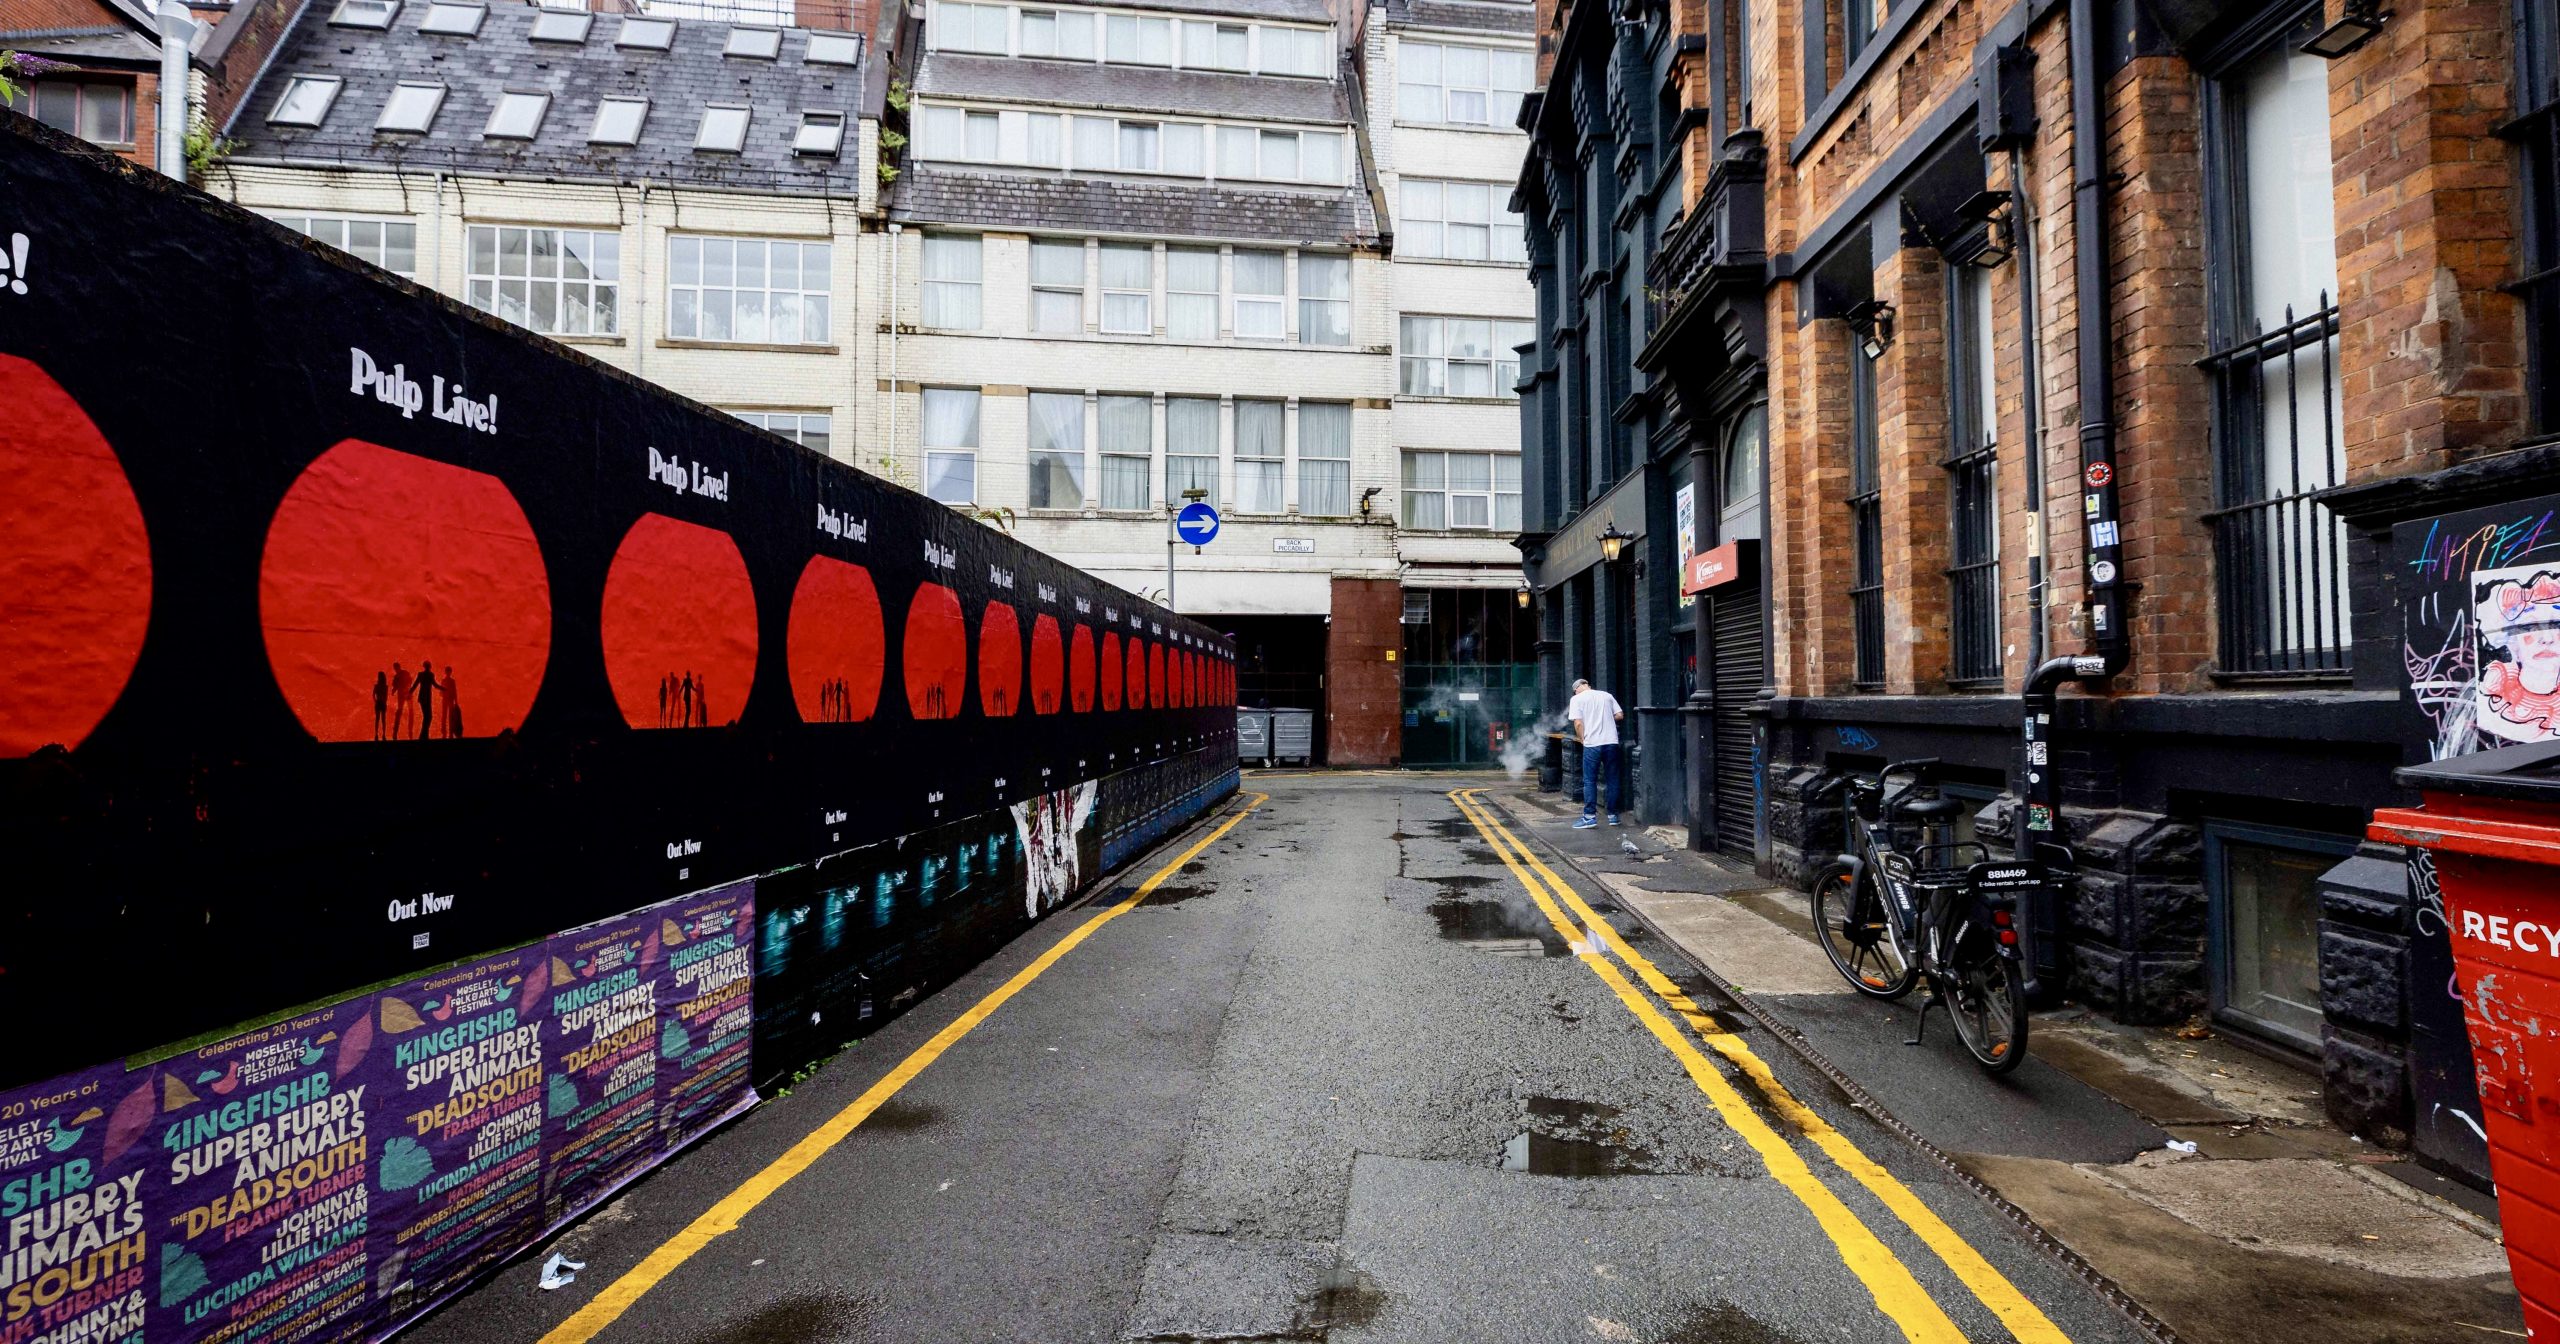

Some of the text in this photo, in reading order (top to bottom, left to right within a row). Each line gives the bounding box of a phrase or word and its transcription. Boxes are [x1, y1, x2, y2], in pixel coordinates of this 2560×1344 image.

[350, 347, 498, 435] Pulp Live!
[648, 447, 729, 502] Pulp Live!
[817, 503, 867, 543] Pulp Live!
[924, 539, 940, 569] Pulp
[667, 838, 701, 859] Out Now
[1988, 869, 2027, 878] 88M469
[388, 892, 454, 922] Out Now
[598, 942, 622, 956] MOSELEY
[598, 958, 622, 972] FESTIVAL
[670, 933, 735, 971] KINGFISHR
[676, 944, 750, 988] SUPER FURRY
[424, 958, 520, 991] Celebrating 20 Years of
[456, 979, 493, 996] MOSELEY
[554, 968, 638, 1016] KINGFISHR
[697, 960, 749, 996] ANIMALS
[450, 993, 471, 1008] FOLK
[478, 986, 499, 1000] ARTS
[456, 997, 493, 1016] FESTIVAL
[562, 980, 656, 1035] SUPER FURRY
[695, 1008, 720, 1026] FRANK
[198, 1010, 334, 1059] Celebrating 20 Years of
[396, 1008, 518, 1070] KINGFISHR
[592, 998, 656, 1043] ANIMALS
[237, 1059, 265, 1078] FOLK
[278, 1046, 306, 1065] ARTS
[246, 1038, 298, 1063] MOSELEY
[406, 1020, 542, 1091] SUPER FURRY
[449, 1041, 542, 1098] ANIMALS
[587, 1036, 656, 1079] FRANK TURNER
[245, 1062, 296, 1086] FESTIVAL
[604, 1060, 656, 1098] LILLIE FLYNN
[2, 1080, 100, 1120] 20 Years of
[406, 1114, 418, 1124] THE
[444, 1086, 541, 1141] FRANK TURNER
[566, 1098, 610, 1132] LUCINDA
[610, 1074, 656, 1105] WILLIAMS
[11, 1128, 53, 1154] ARTS
[171, 1084, 366, 1185] SUPER FURRY
[233, 1110, 365, 1189] ANIMALS
[468, 1114, 541, 1160] LILLIE FLYNN
[418, 1161, 478, 1204] LUCINDA
[478, 1128, 541, 1170] WILLIAMS
[448, 1164, 504, 1203] KATHERINE
[505, 1146, 540, 1175] PRIDDY
[10, 1168, 145, 1251] FURRY
[170, 1212, 189, 1227] THE
[224, 1163, 366, 1244] FRANK TURNER
[410, 1204, 454, 1236] LONGEST
[454, 1188, 484, 1212] JOHNS
[485, 1178, 507, 1196] JANE
[508, 1159, 540, 1181] WEAVER
[261, 1197, 368, 1264] LILLIE FLYNN
[184, 1264, 276, 1325] LUCINDA
[276, 1216, 368, 1275] WILLIAMS
[231, 1237, 367, 1320] KATHERINE PRIDDY
[240, 1253, 368, 1330] JOHNS JANE WEAVER
[306, 1266, 366, 1310] PENTANGLE
[40, 1267, 144, 1329] TURNER
[273, 1307, 320, 1340] HUDSON
[322, 1281, 366, 1314] FREEMAN
[330, 1292, 366, 1321] SALACH
